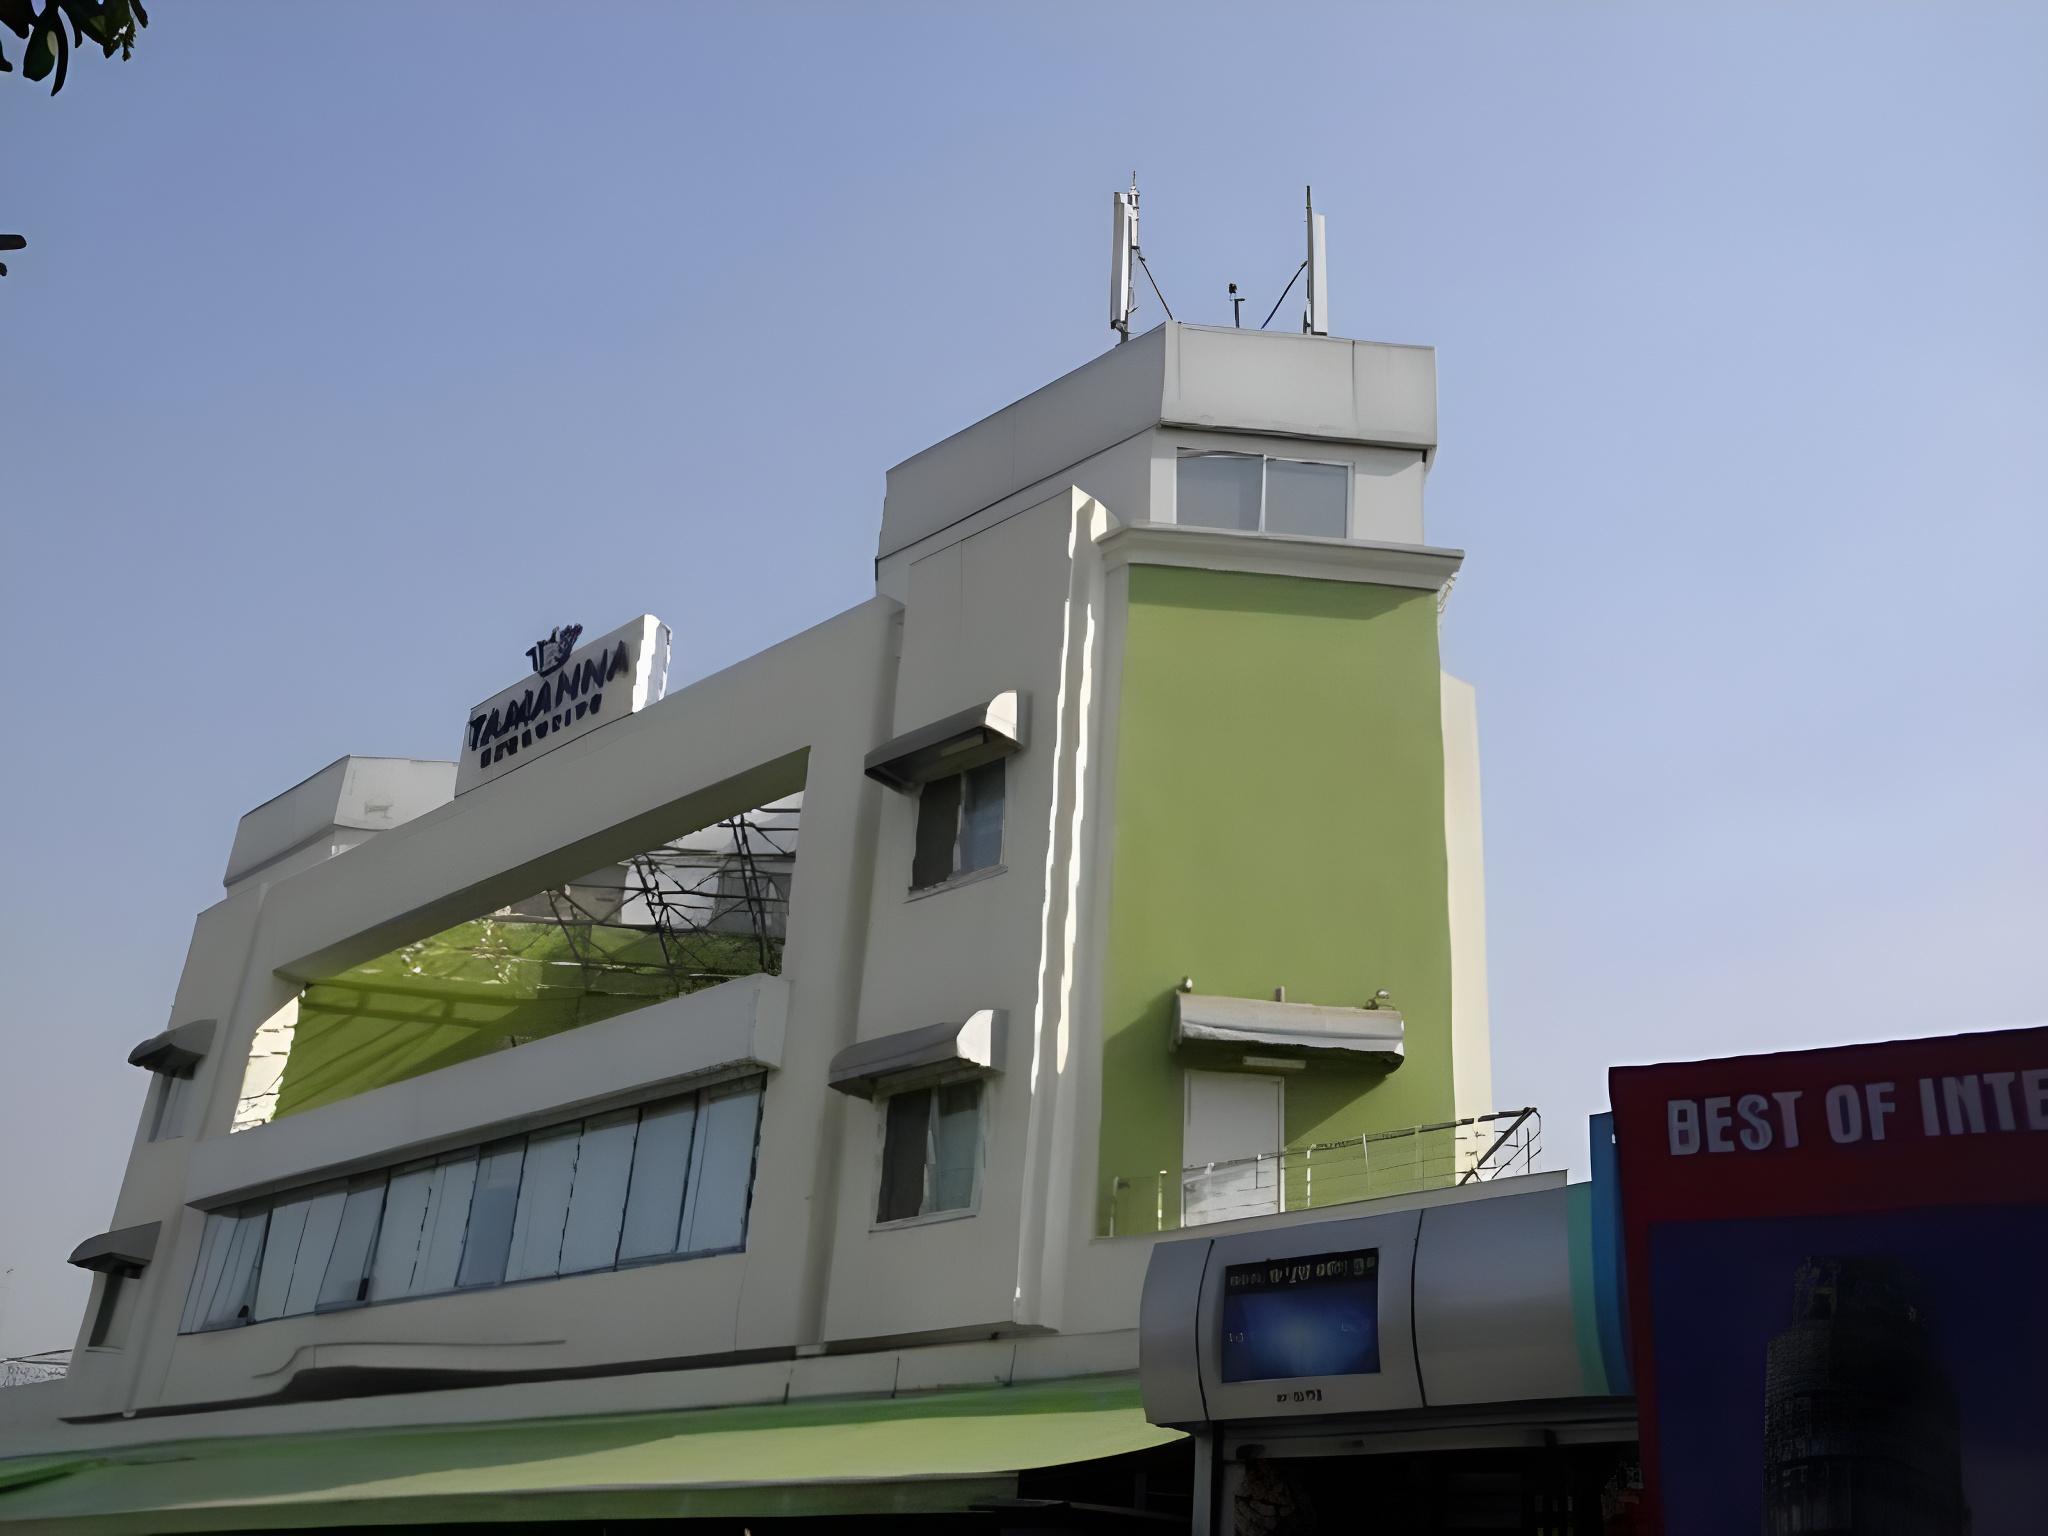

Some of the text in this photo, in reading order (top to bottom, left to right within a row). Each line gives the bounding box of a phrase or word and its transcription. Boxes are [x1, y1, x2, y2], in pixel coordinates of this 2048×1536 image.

[1667, 1068, 2048, 1156] BEST OF INTE
